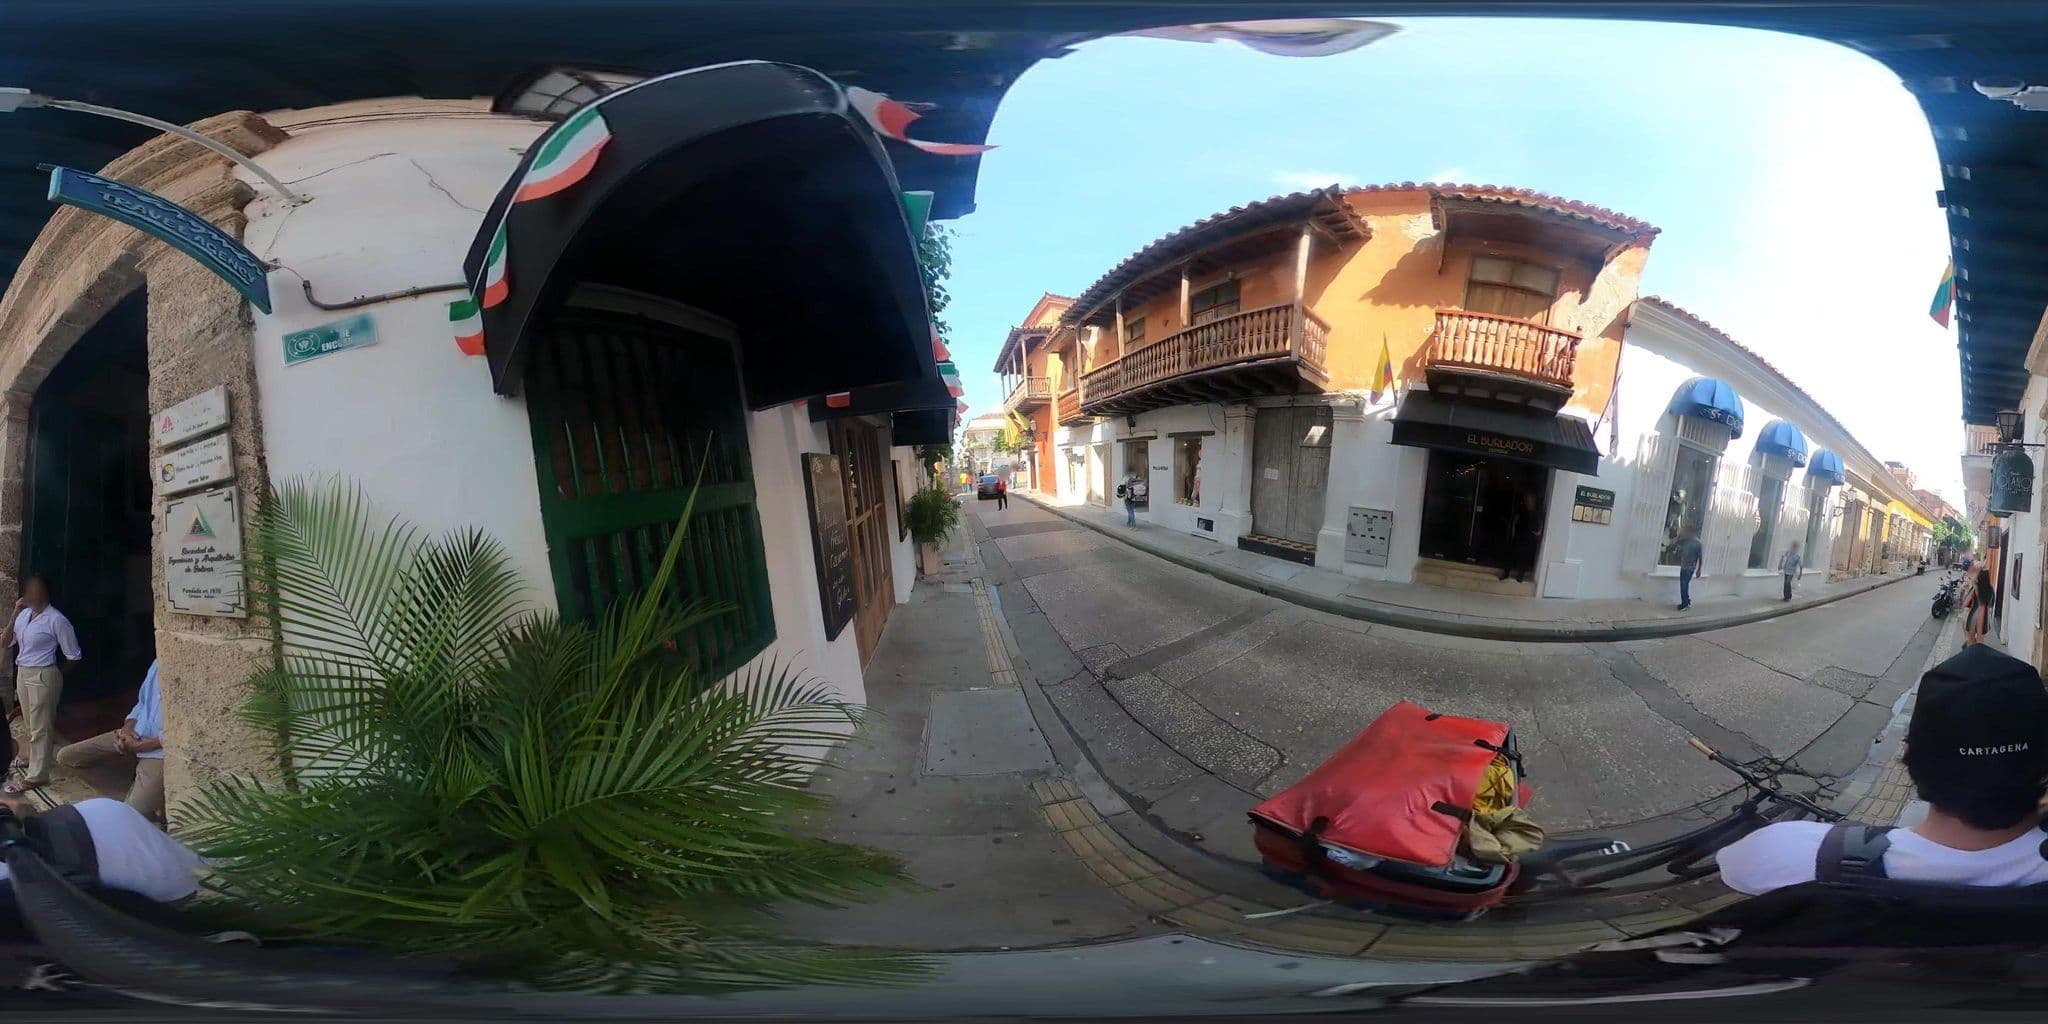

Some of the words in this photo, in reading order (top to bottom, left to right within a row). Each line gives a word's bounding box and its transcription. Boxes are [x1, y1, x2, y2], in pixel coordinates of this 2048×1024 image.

[99, 191, 189, 235] TRAVEL
[195, 235, 257, 283] AGENCY
[1960, 743, 2029, 756] CARTAGENA
